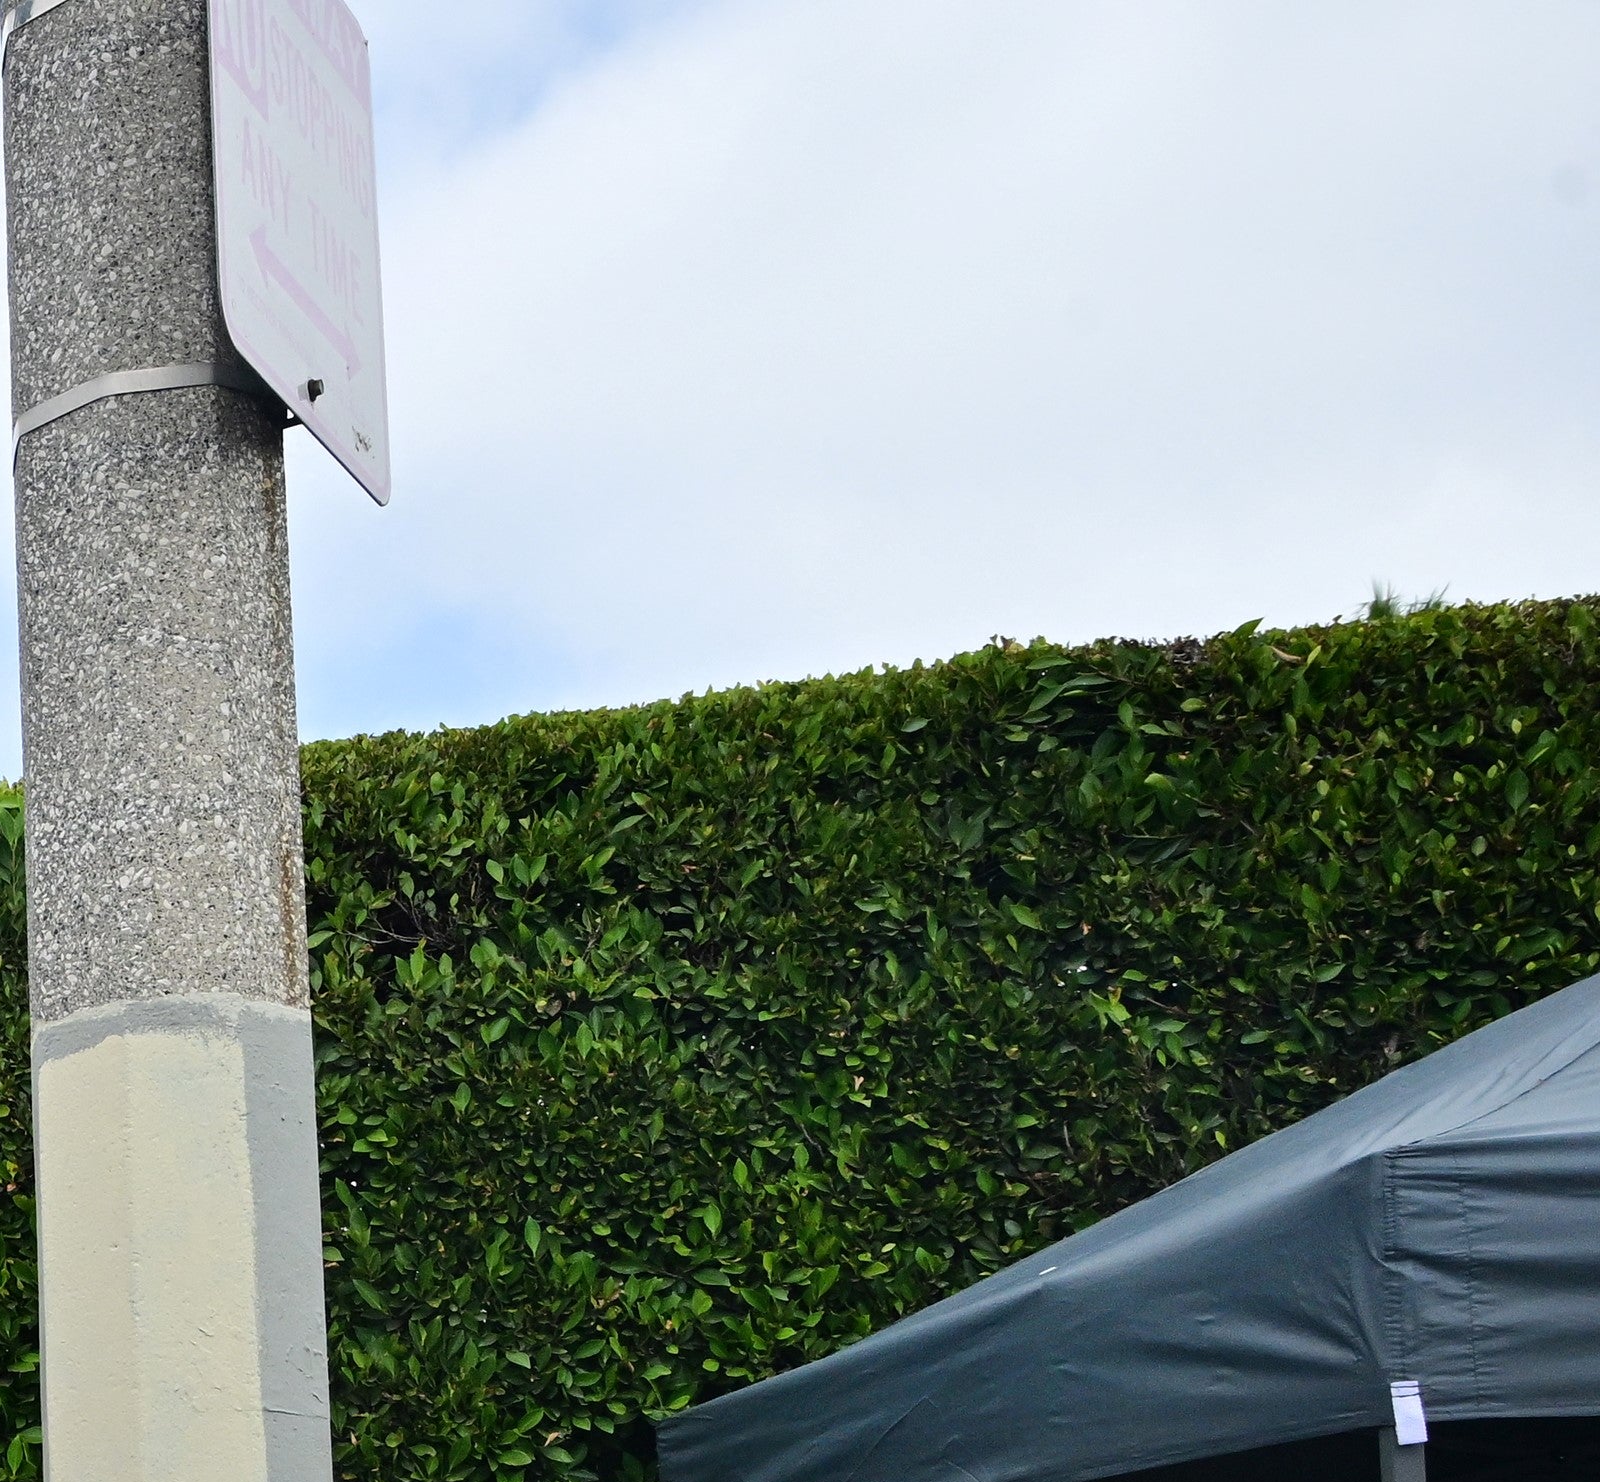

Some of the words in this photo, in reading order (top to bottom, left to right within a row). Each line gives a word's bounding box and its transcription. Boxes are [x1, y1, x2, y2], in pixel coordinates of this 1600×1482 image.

[270, 14, 371, 218] STOPPING
[241, 117, 291, 236] ANY
[307, 195, 364, 326] TIME
